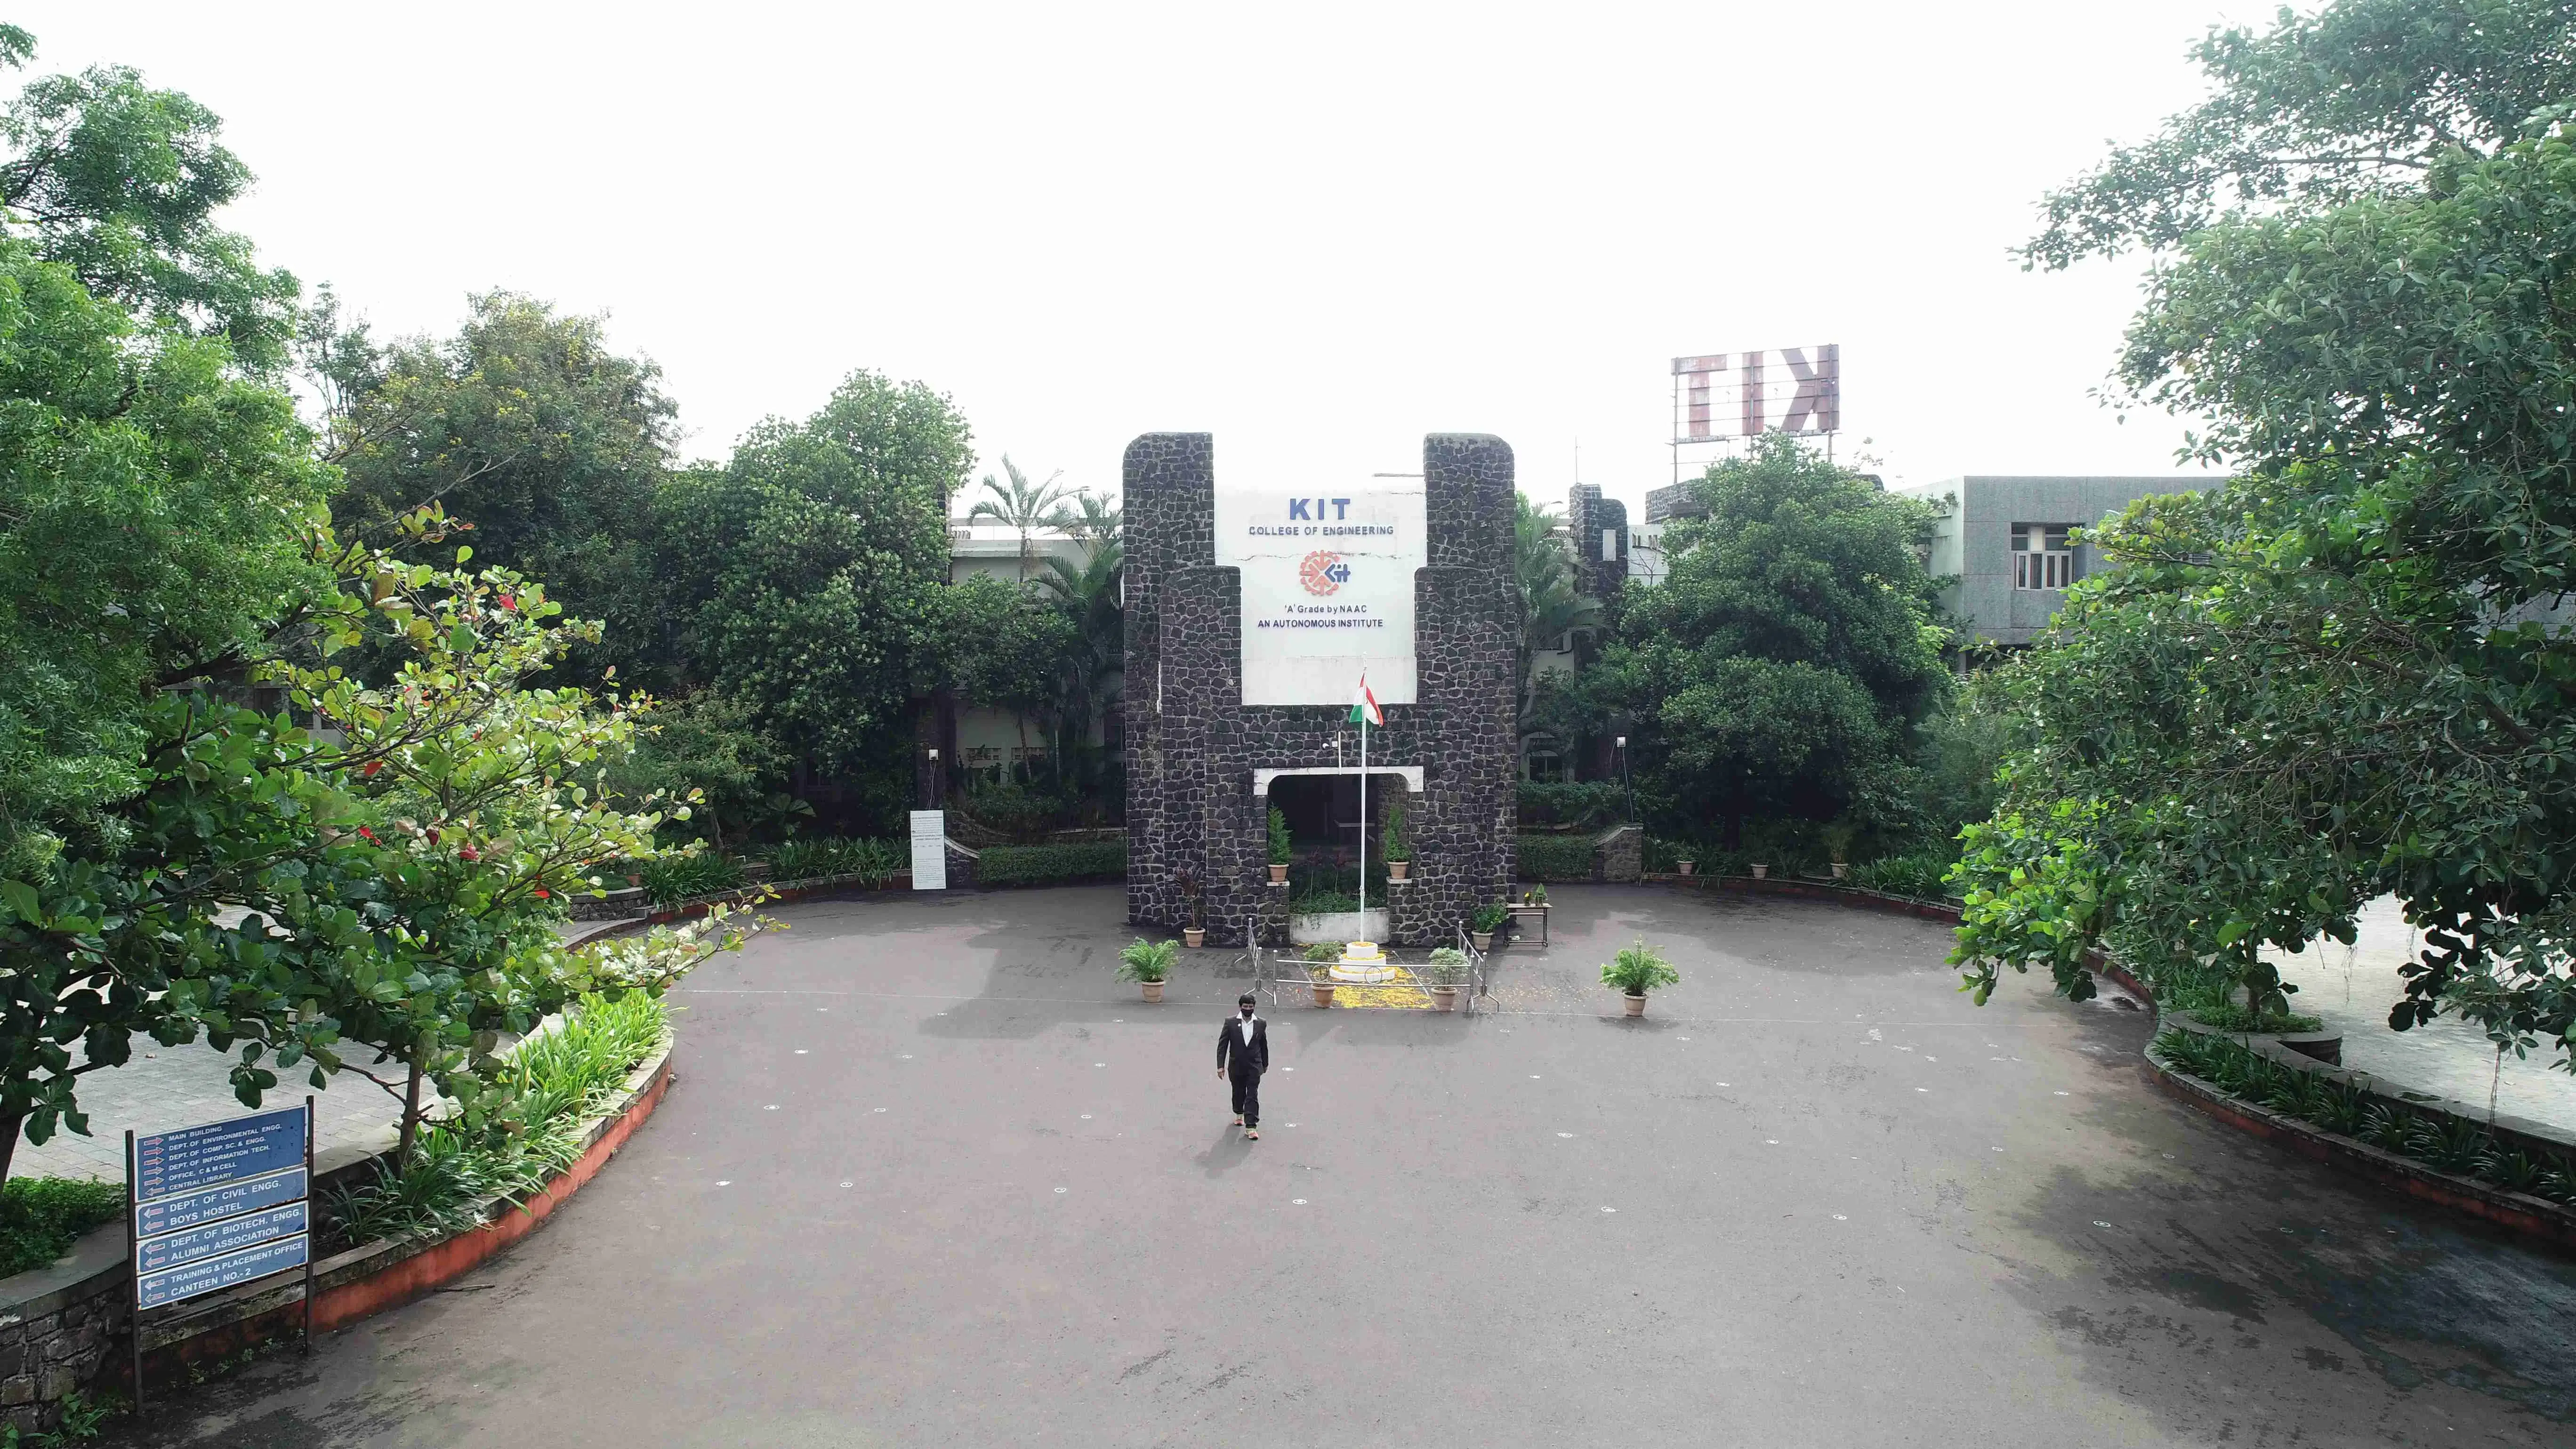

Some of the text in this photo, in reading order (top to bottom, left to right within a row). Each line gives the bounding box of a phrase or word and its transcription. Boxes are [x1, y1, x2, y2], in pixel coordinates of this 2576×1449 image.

[1289, 498, 1351, 521] KIT
[1249, 526, 1394, 536] COLLEGE OF ENGINEERING
[1297, 605, 1324, 613] Grade
[1327, 605, 1338, 615] by
[1340, 605, 1367, 613] NAAC
[1257, 619, 1383, 628] AN AUTONOMOUS INSTITUTE
[169, 1126, 223, 1141] MAIN BUILDING
[169, 1143, 189, 1151] DEPT.
[202, 1128, 259, 1144] ENVIRONMENTAL
[262, 1124, 282, 1132] ENGG.
[169, 1152, 189, 1161] DEPT.
[202, 1145, 223, 1154] COMP.
[246, 1136, 266, 1145] ENGG.
[169, 1162, 189, 1171] DEPT.
[202, 1149, 249, 1164] INFORMATION
[251, 1144, 271, 1153] TECH.
[219, 1161, 237, 1170] CELL
[169, 1172, 233, 1191] CENTRAL LIBRARY
[169, 1180, 282, 1212] DEPT. OF CIVIL ENGG.
[170, 1202, 243, 1225] BOYS HOSTEL
[171, 1208, 302, 1248] DEPT. OF BIOTECH. ENGG.
[170, 1226, 280, 1261] ALUMNI ASSOCIATION
[170, 1266, 212, 1283] TRAINING
[222, 1250, 272, 1270] PLACEMENT
[274, 1241, 304, 1255] OFFICE
[171, 1276, 218, 1296] CANTEEN
[245, 1268, 251, 1276] 2
